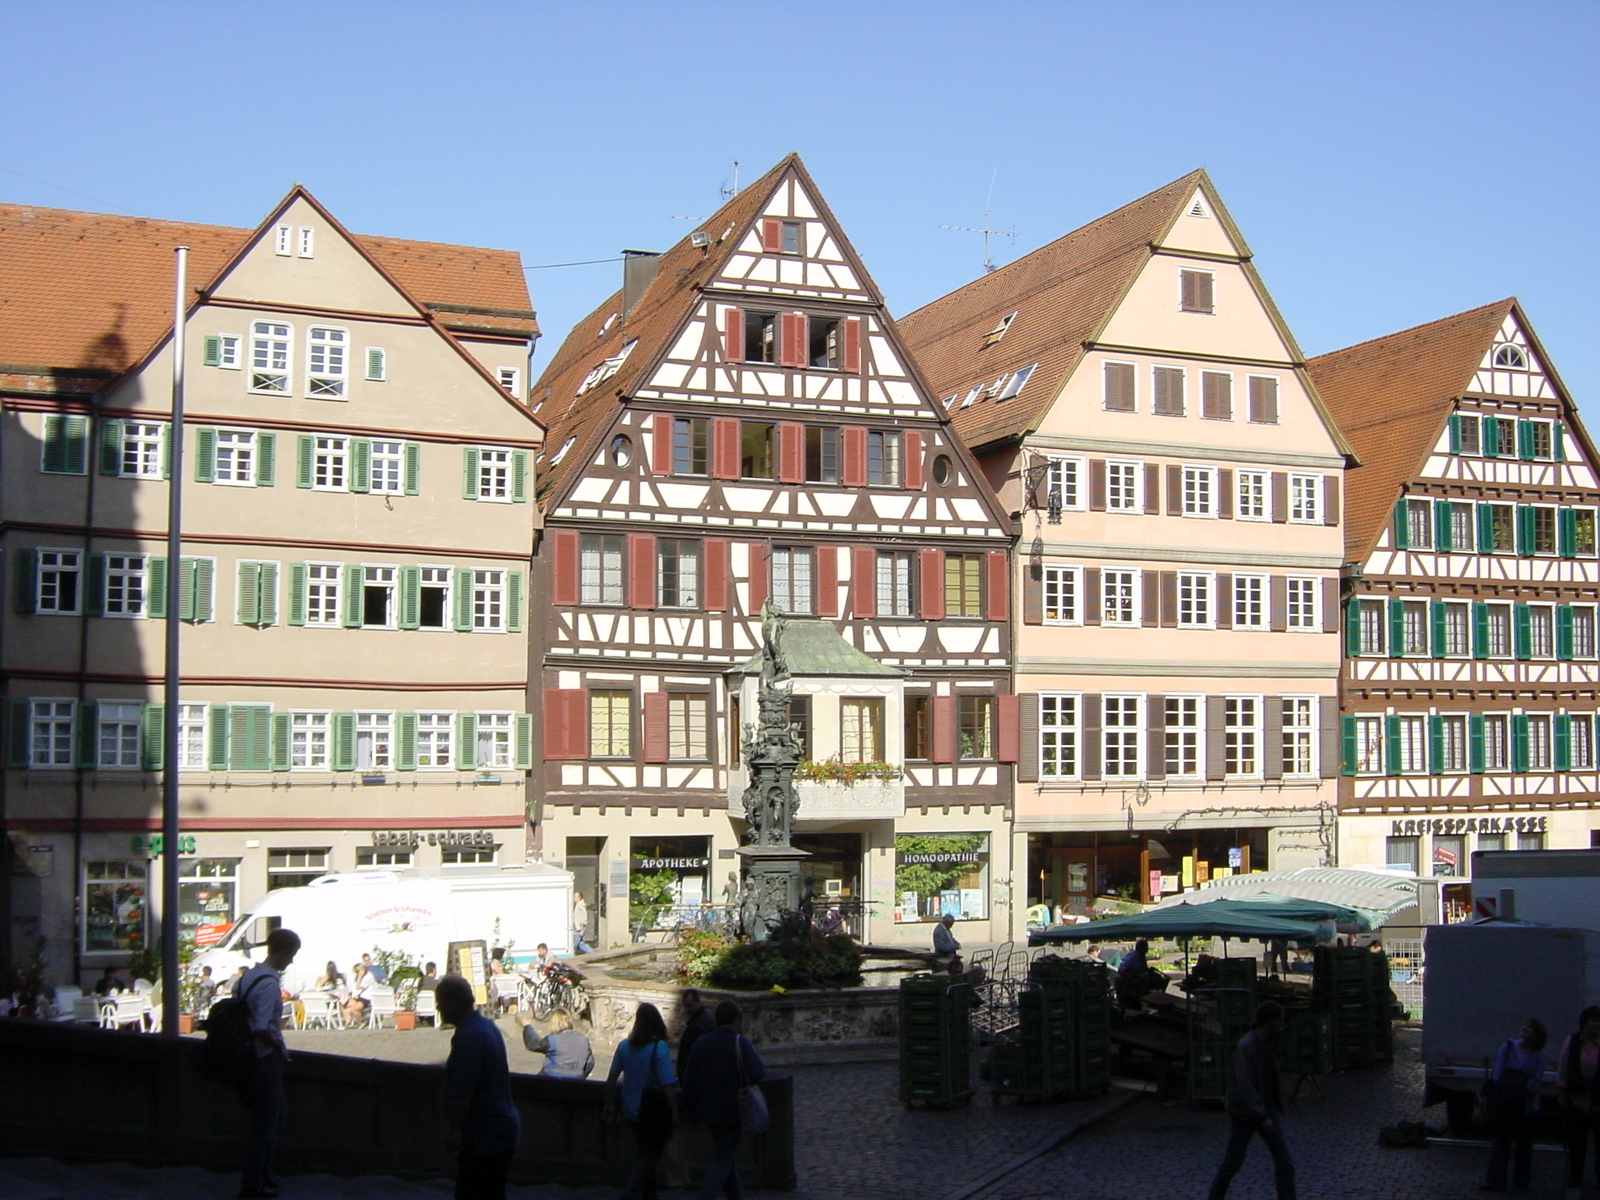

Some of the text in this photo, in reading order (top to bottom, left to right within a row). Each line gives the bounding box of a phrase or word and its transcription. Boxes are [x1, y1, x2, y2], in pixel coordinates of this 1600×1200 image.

[1391, 816, 1548, 836] KREISSPARKASSE
[131, 835, 196, 857] e-pus
[372, 830, 494, 846] tabak-schrade
[641, 858, 700, 869] APOTHEKE
